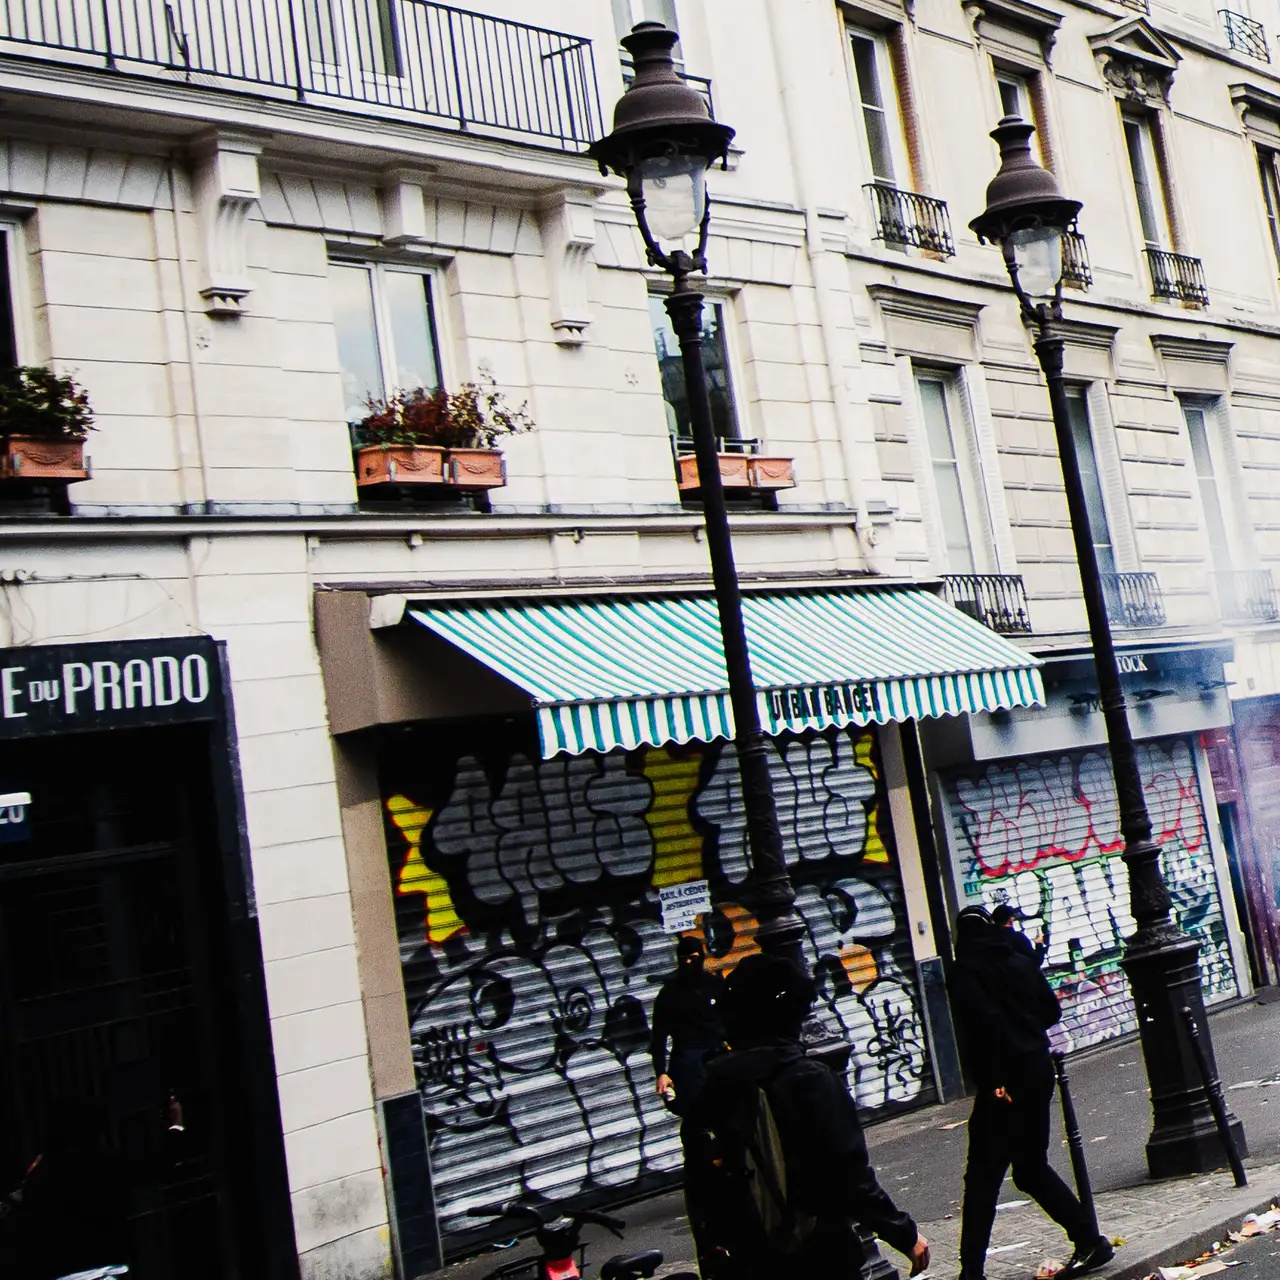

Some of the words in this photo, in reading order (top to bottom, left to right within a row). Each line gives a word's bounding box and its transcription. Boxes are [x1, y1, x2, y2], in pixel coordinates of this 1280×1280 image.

[28, 679, 60, 703] DU
[62, 653, 210, 715] PRADO
[1115, 654, 1149, 674] TOCK
